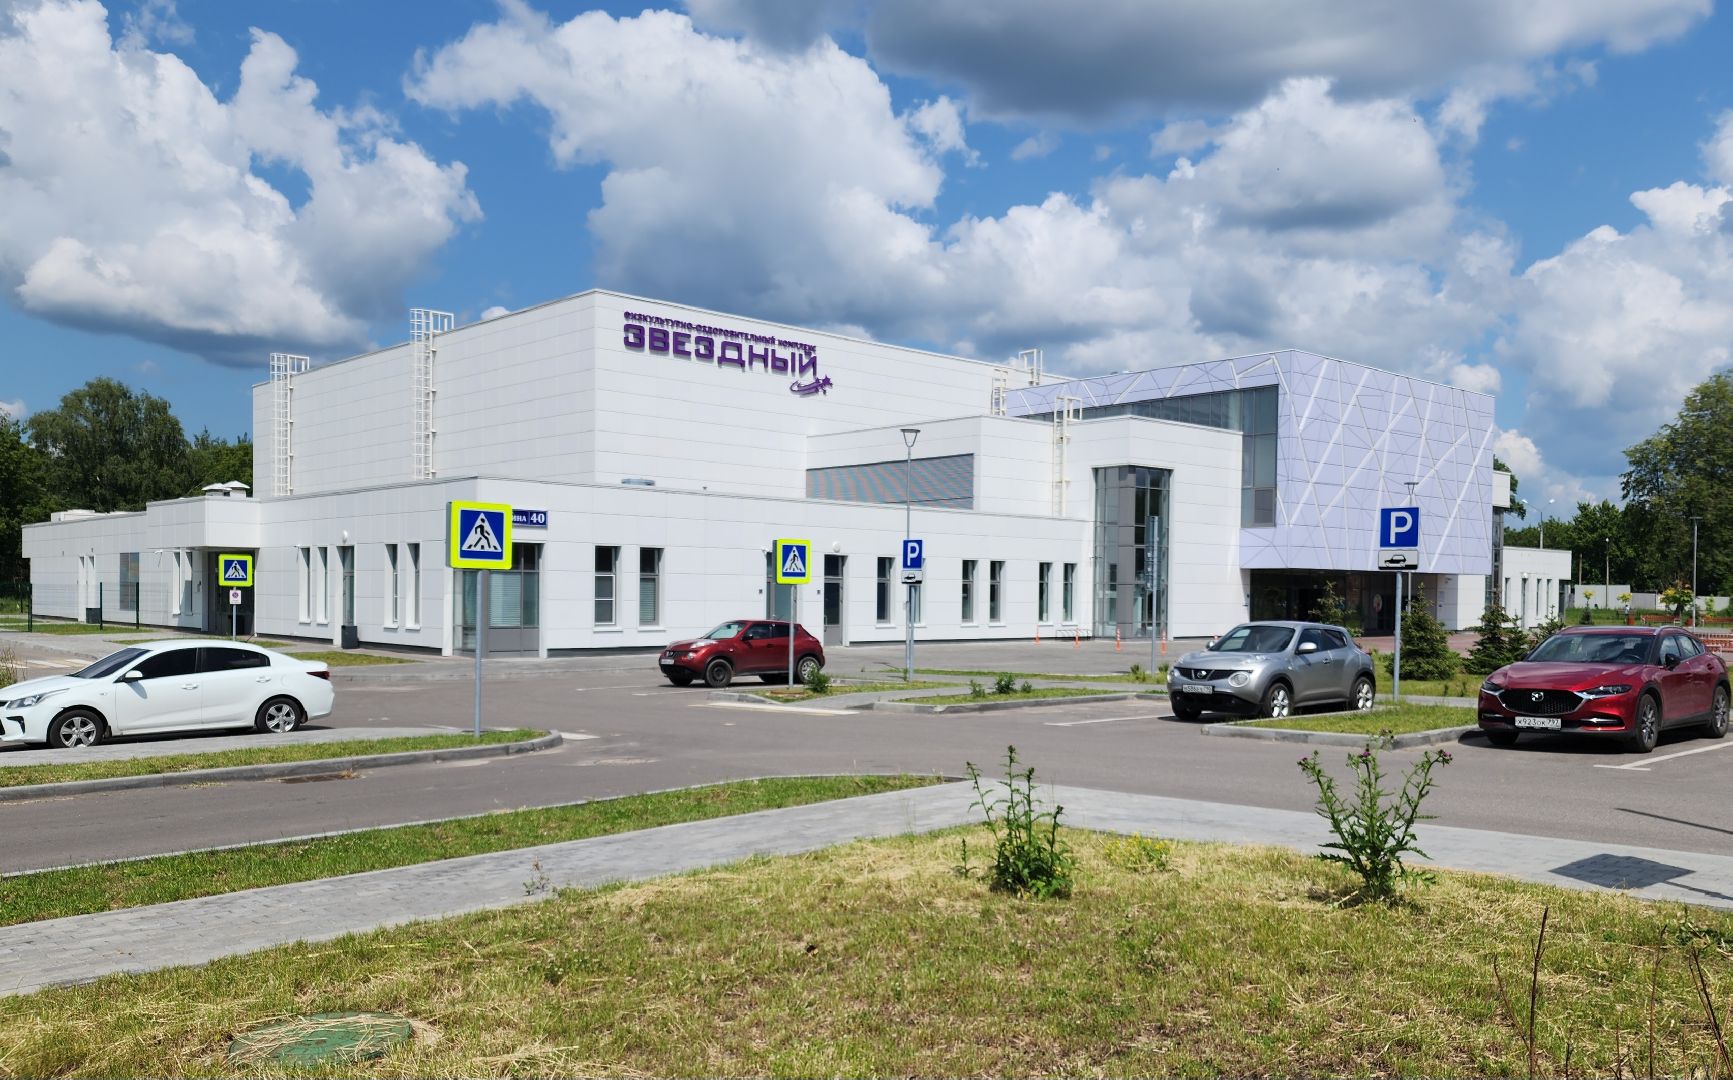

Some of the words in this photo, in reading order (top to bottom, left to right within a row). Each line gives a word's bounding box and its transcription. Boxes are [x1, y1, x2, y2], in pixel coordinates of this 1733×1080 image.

[624, 311, 776, 346] ФИЗКУЛЬТУРНО-ОЗДОРОВИТЕЛЬНЫЙ
[777, 338, 817, 353] КОМПЛЕКС
[623, 323, 817, 377] ЗВЕЗДНЫЙ
[530, 513, 545, 524] 40
[1389, 511, 1413, 545] P
[907, 542, 920, 567] P
